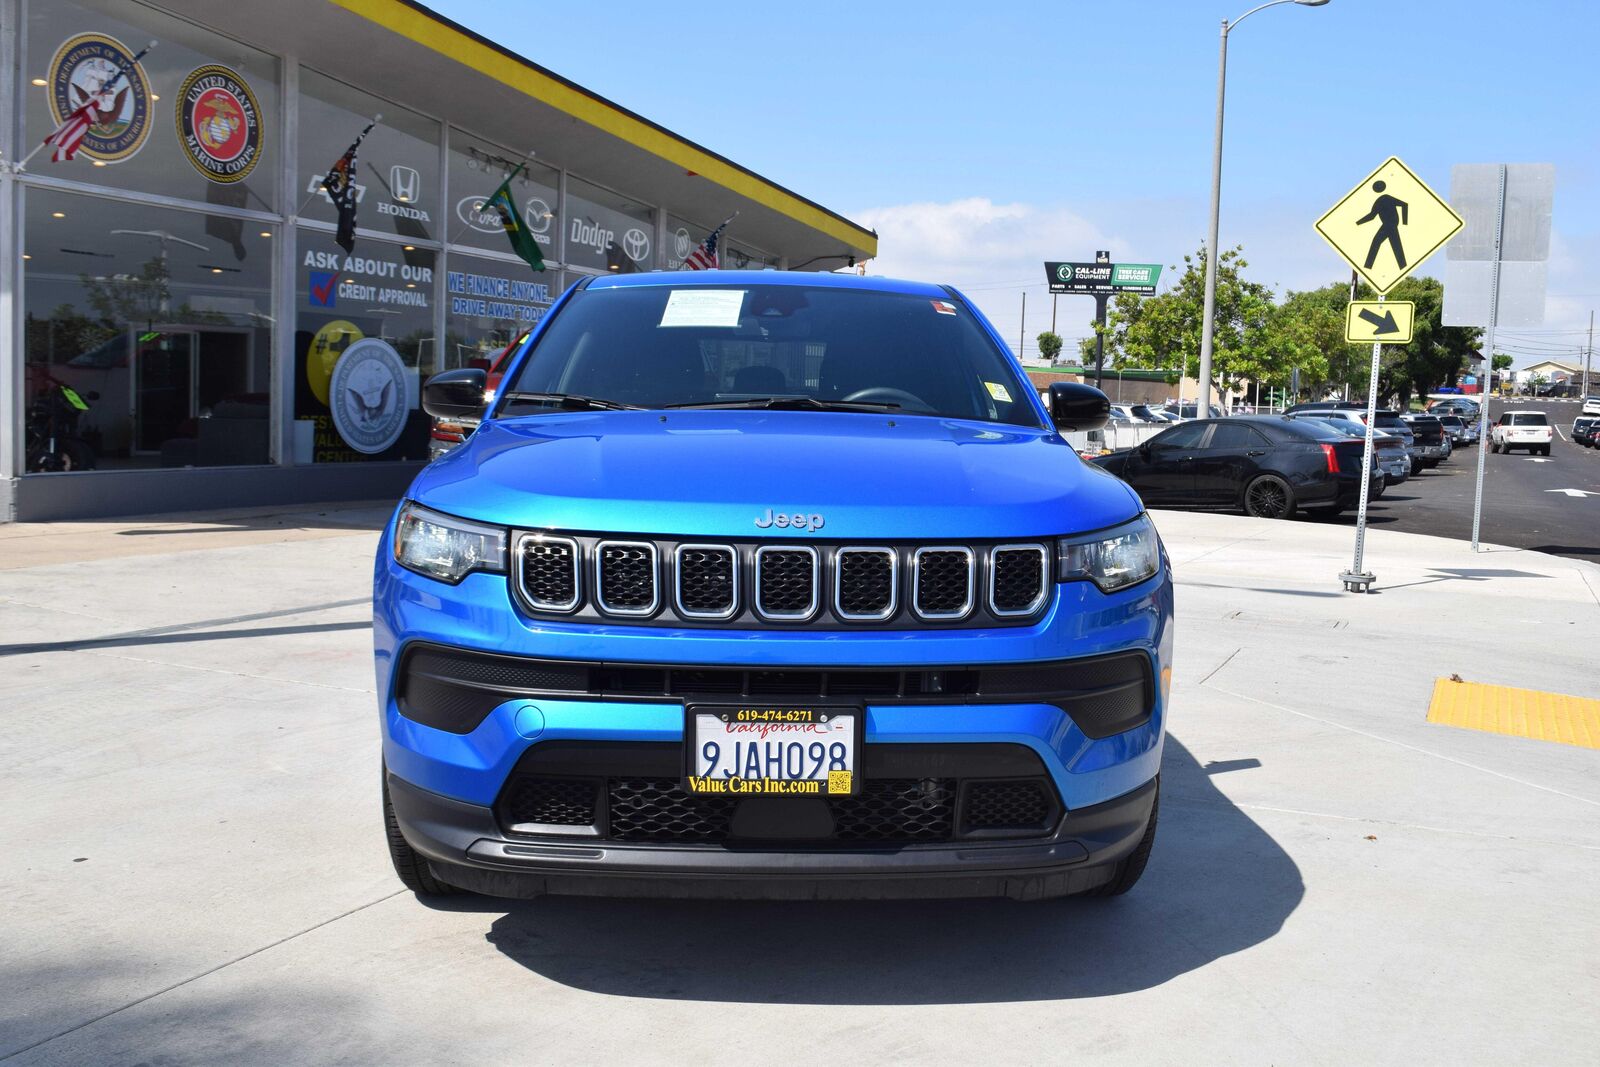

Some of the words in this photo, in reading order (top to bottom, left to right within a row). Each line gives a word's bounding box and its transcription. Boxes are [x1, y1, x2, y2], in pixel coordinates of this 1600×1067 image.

[187, 76, 226, 102] UNITED
[226, 82, 256, 127] STATES
[185, 134, 224, 173] MARINE
[226, 145, 255, 173] CORPS
[376, 201, 432, 223] HONDA
[570, 218, 614, 254] Dodge
[303, 250, 339, 270] ASK
[343, 256, 398, 278] ABOUT
[401, 264, 432, 283] OUR
[338, 283, 377, 301] CREDIT
[378, 287, 428, 307] APPROVAL
[448, 271, 465, 294] WE
[465, 273, 509, 299] FINANCE
[452, 297, 486, 317] DRIVE
[487, 301, 516, 320] AWAY
[517, 304, 549, 322] TODA
[755, 508, 826, 532] Jeep
[737, 710, 813, 722] 619-474-6271
[702, 740, 847, 779] 9JAH098
